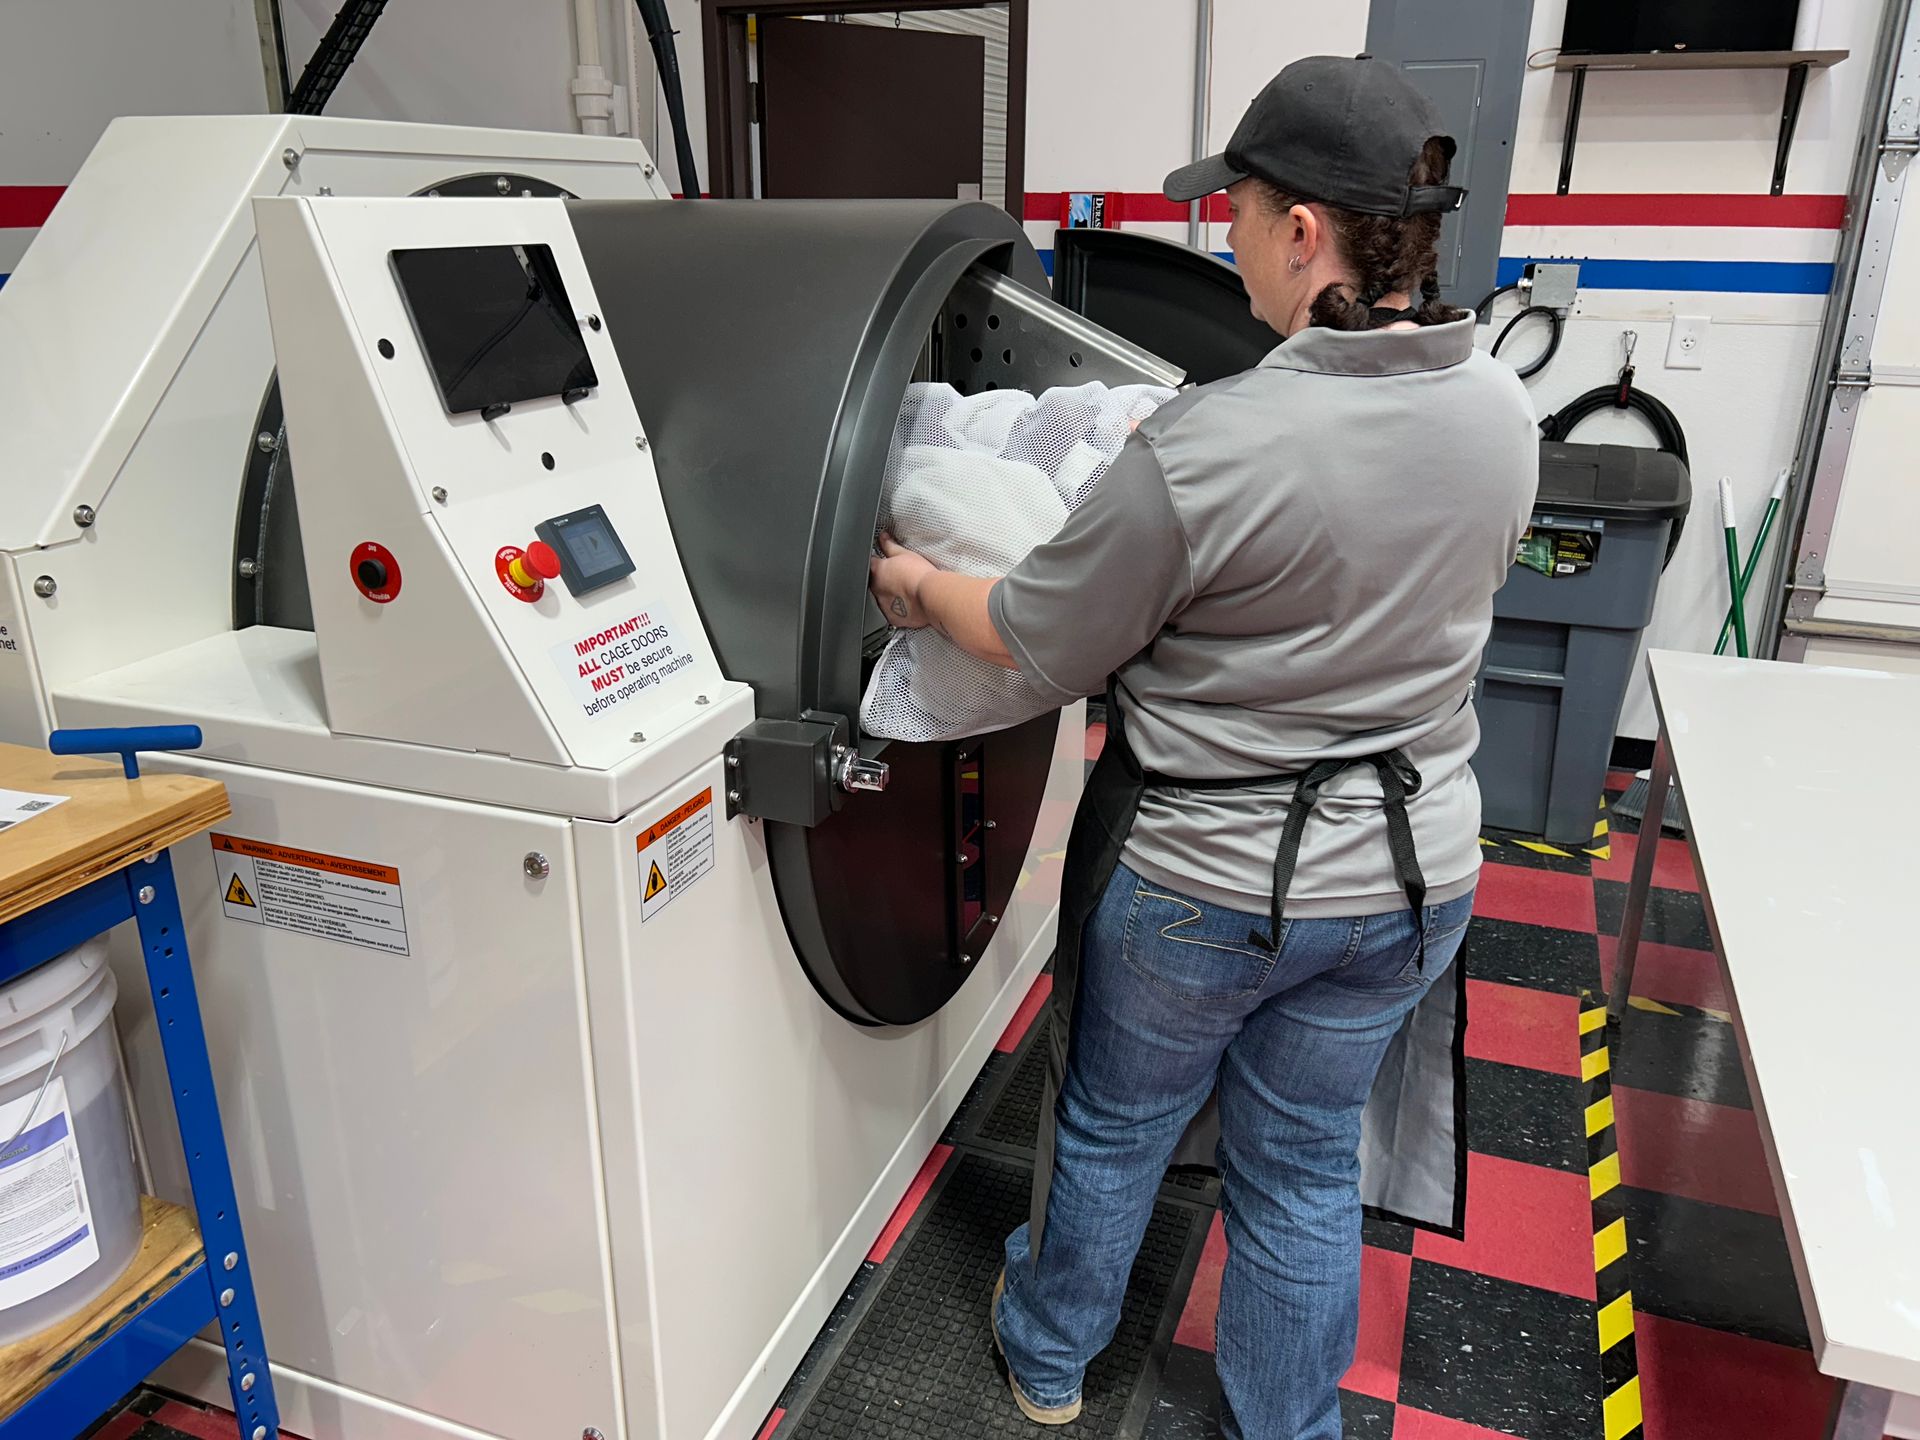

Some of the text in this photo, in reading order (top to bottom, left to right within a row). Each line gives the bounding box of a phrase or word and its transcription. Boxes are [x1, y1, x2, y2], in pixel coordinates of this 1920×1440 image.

[574, 612, 651, 656] IMPORTANT!!!
[577, 625, 668, 678] ALL CAGE DOORS
[583, 653, 694, 716] before operating machine
[591, 645, 673, 692] MUST be secure
[660, 813, 681, 831] DANGER
[684, 796, 704, 815] PELIGRO
[241, 844, 273, 856] WARNING
[278, 851, 325, 866] ADVERTENCIA
[329, 861, 387, 878] AVERTISSEMENT
